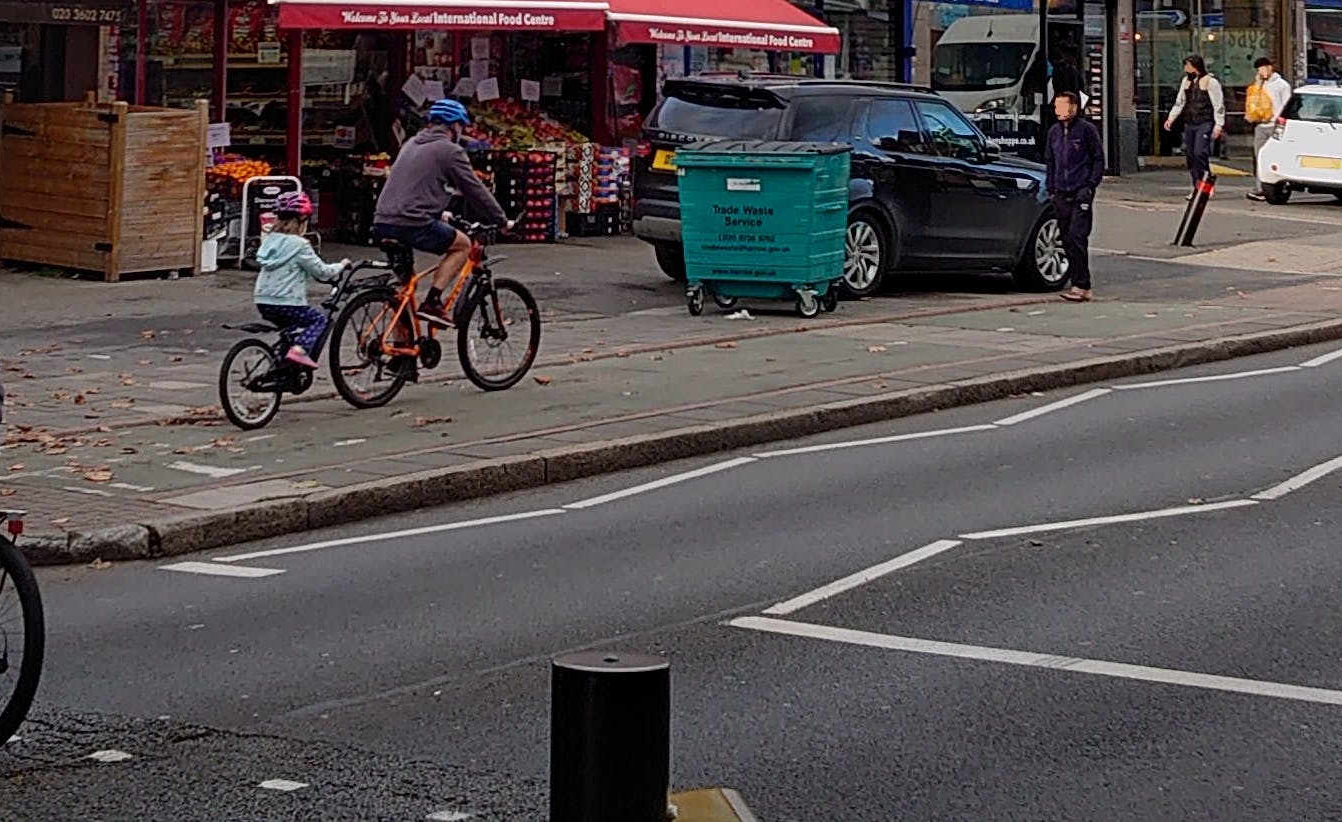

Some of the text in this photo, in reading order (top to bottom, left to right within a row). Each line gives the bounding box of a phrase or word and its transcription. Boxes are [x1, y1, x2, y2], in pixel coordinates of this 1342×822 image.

[51, 8, 70, 19] 020
[73, 8, 97, 20] 3602
[342, 11, 554, 26] Welcome To Your Local International Food Centre
[649, 28, 676, 40] Welcome
[718, 31, 768, 46] International
[769, 35, 787, 47] Food
[788, 36, 813, 48] Centre
[713, 204, 774, 216] Trade Waste
[724, 216, 763, 227] Service
